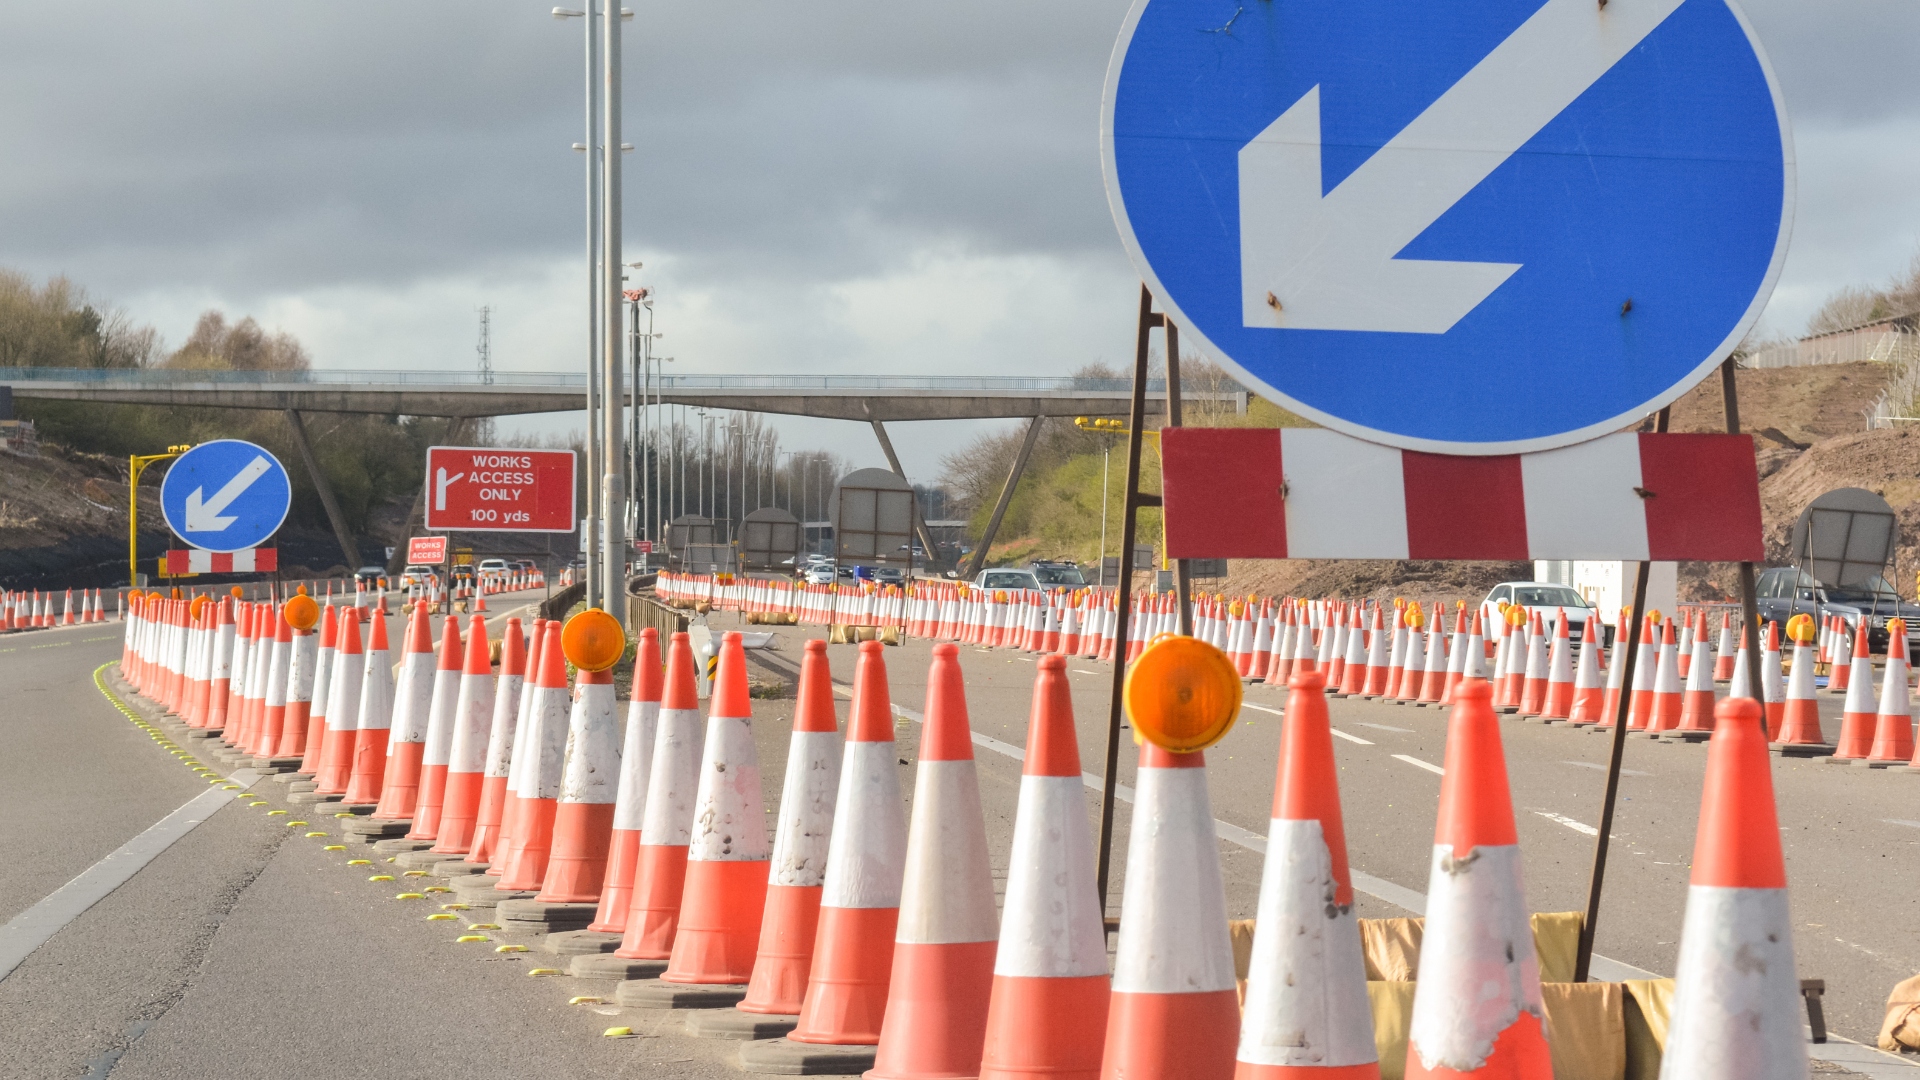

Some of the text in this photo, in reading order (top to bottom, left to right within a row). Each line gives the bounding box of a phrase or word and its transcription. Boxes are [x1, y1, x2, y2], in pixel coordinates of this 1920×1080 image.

[473, 455, 531, 468] WORKS
[469, 472, 534, 484] ACCESS
[479, 488, 522, 500] ONLY
[471, 509, 530, 524] 100 yds
[415, 541, 441, 550] WORKS
[412, 551, 442, 559] ACCESS
